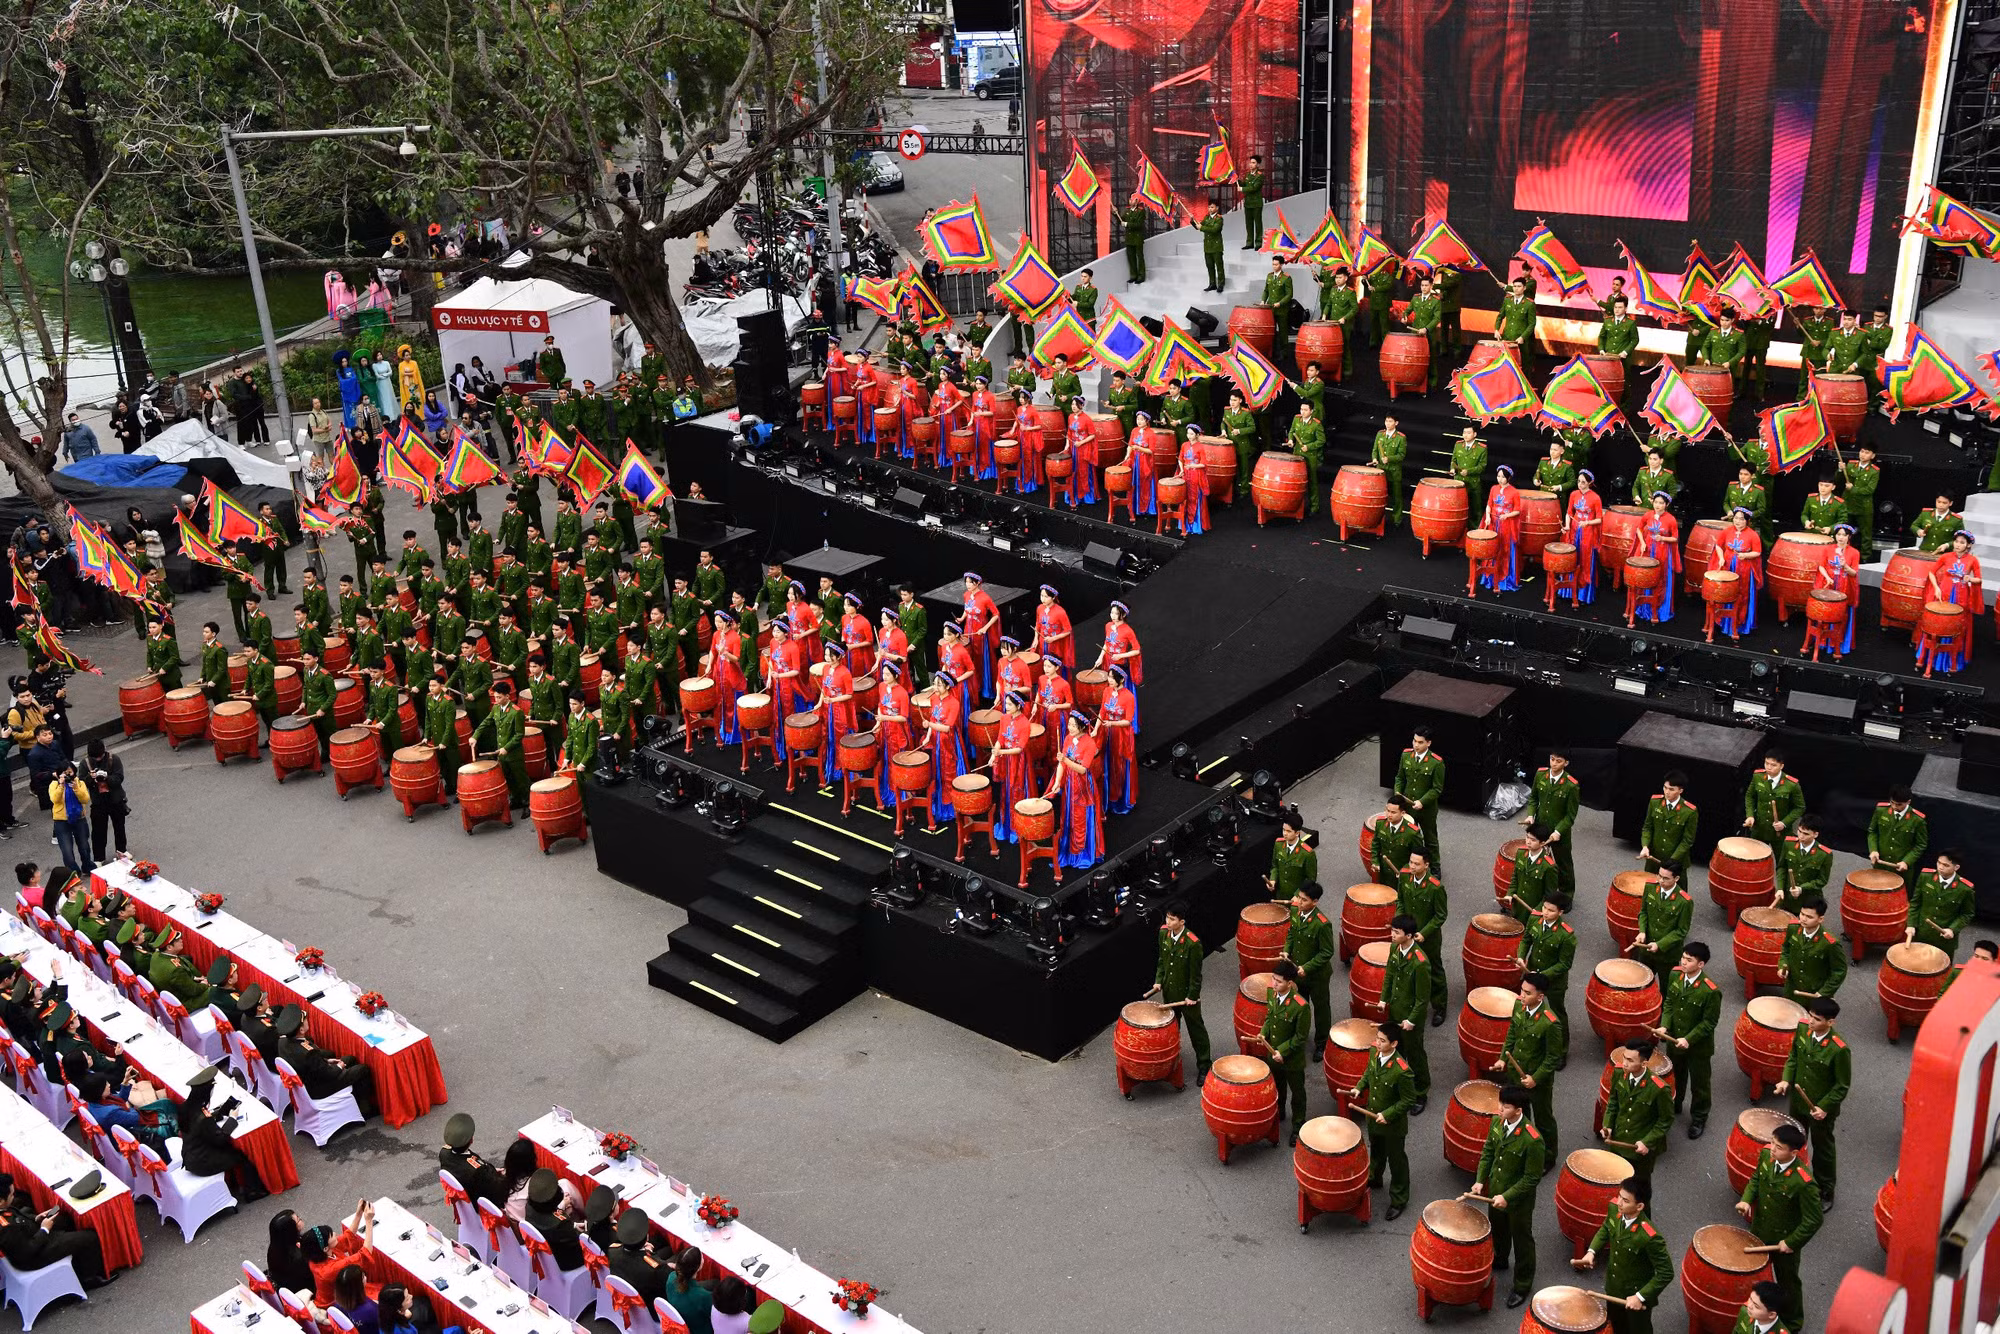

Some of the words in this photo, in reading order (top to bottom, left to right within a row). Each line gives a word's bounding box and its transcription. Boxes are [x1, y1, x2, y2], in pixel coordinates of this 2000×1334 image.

[456, 315, 478, 325] KHU
[479, 316, 500, 328] VỰC
[501, 317, 508, 325] Y
[510, 314, 523, 326] TẾ
